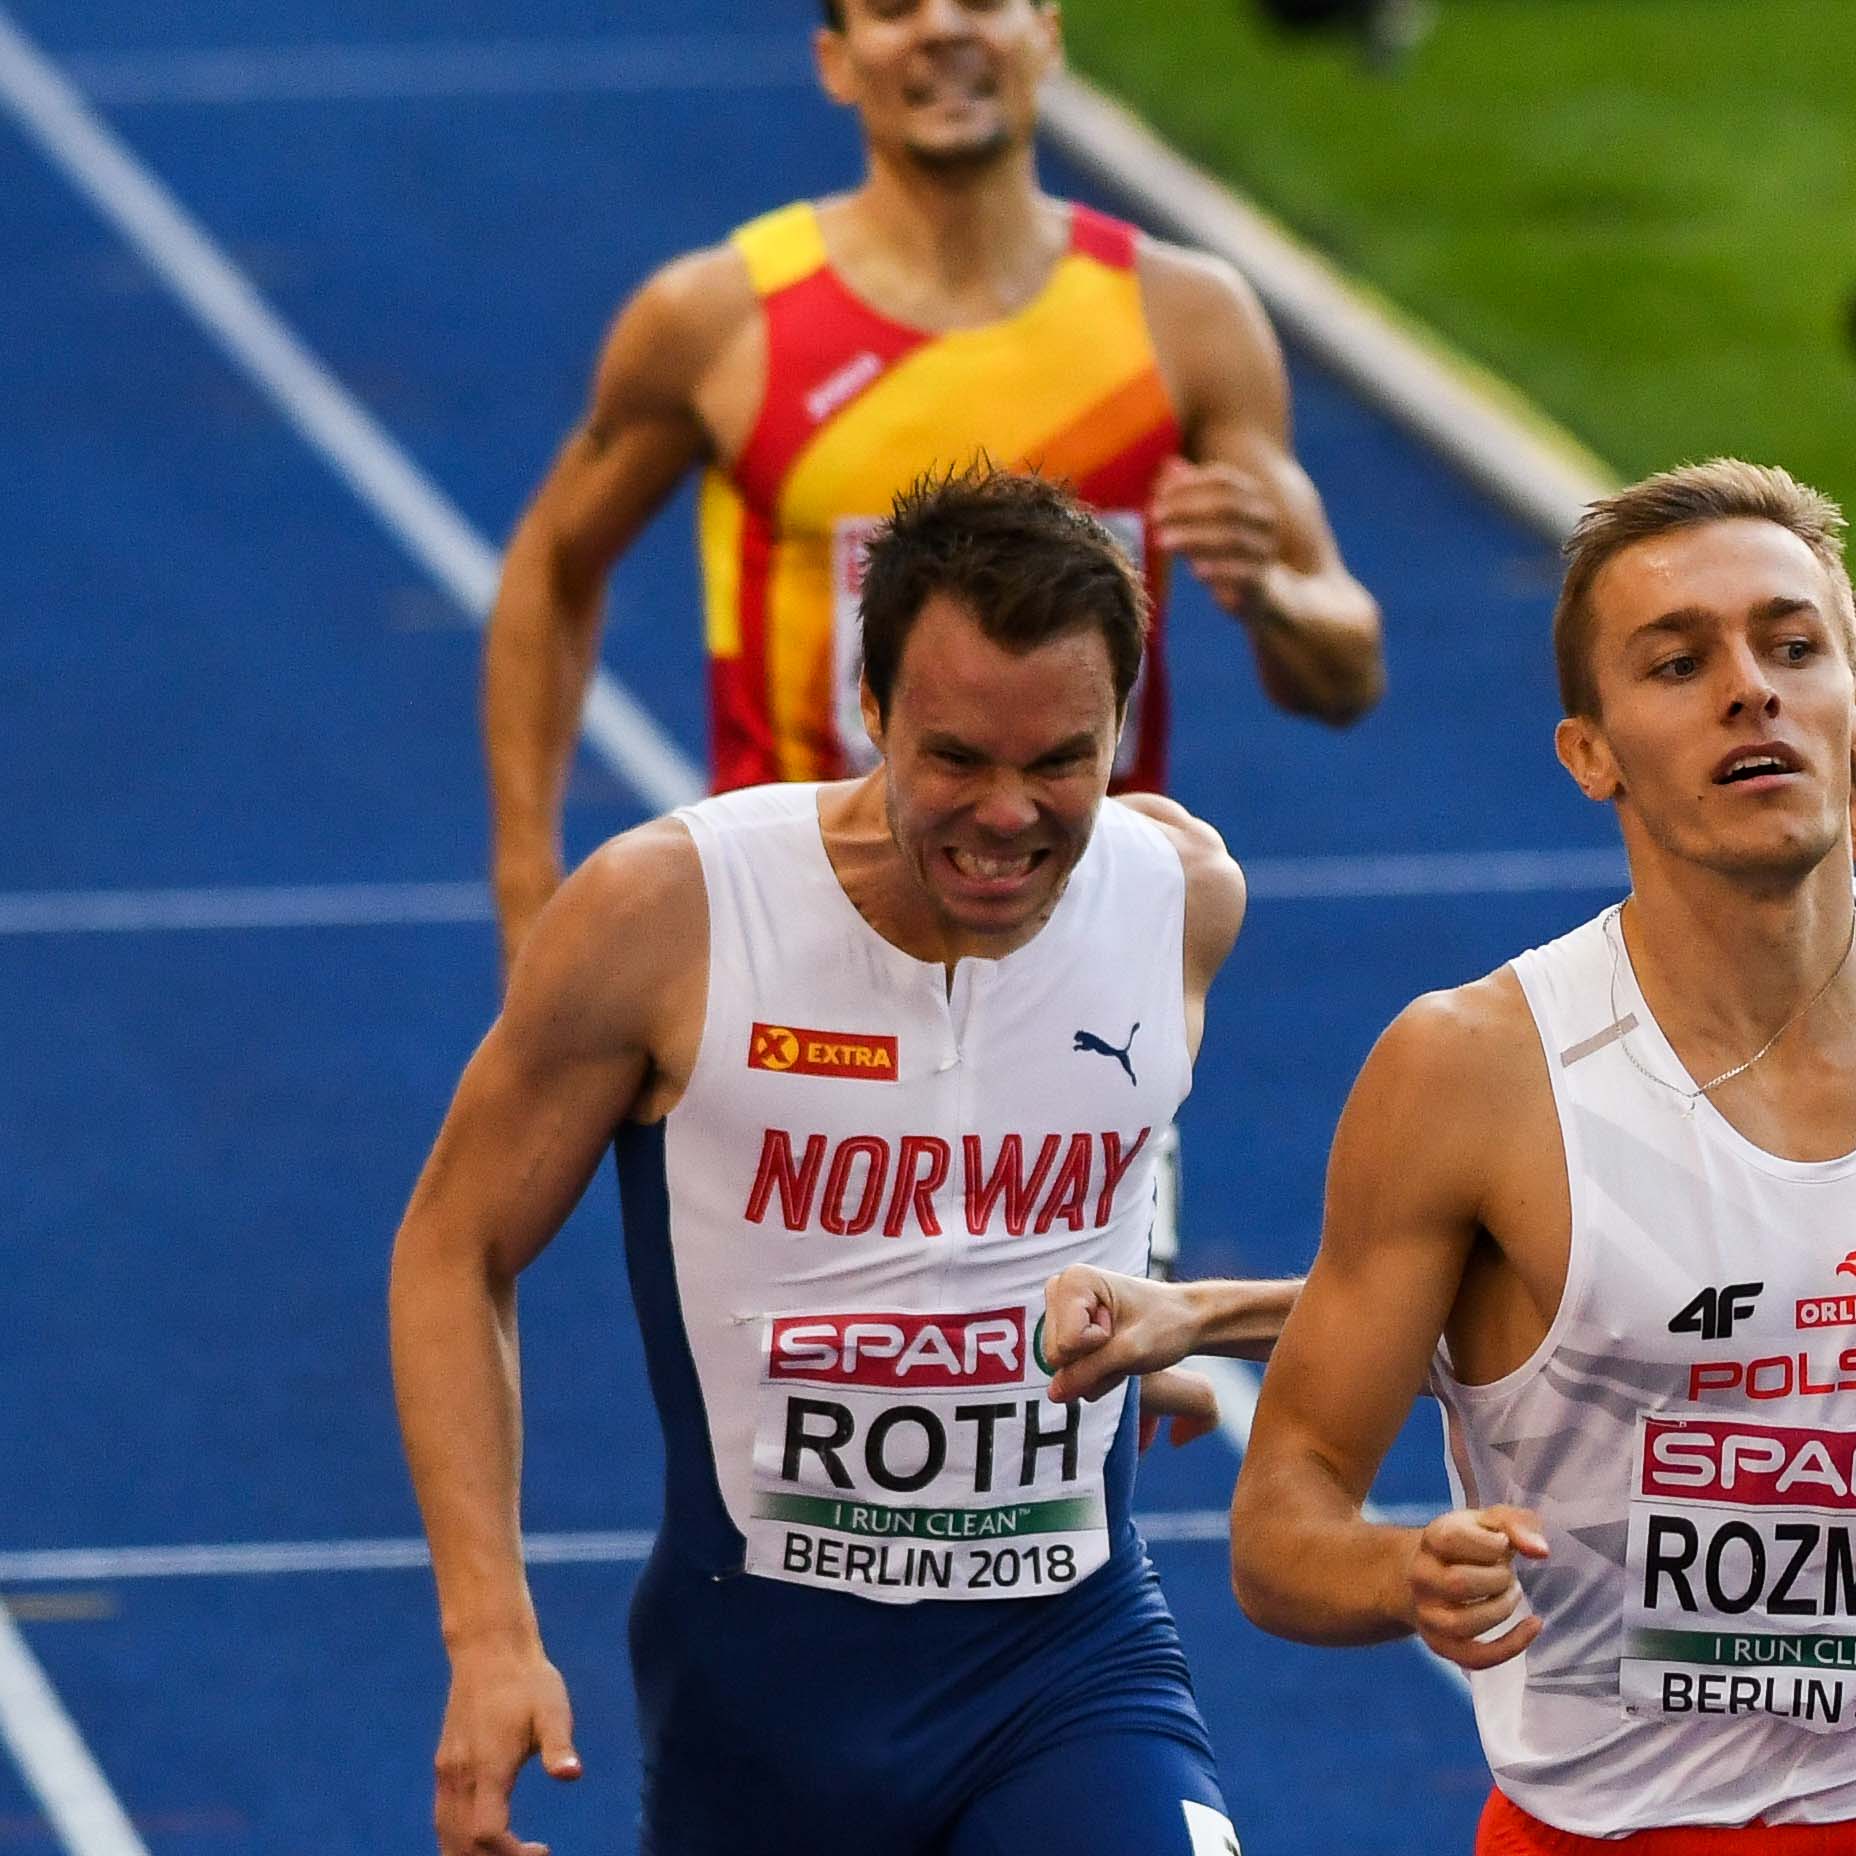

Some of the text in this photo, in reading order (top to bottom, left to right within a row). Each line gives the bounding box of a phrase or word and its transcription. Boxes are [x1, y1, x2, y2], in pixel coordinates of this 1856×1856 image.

[807, 1042, 892, 1068] EXTRA
[744, 1126, 1151, 1238] NORWAY
[1667, 1282, 1764, 1340] 4F
[778, 1320, 1019, 1378] SPAR
[781, 1396, 1082, 1494] ROTH
[833, 1507, 842, 1527] I
[851, 1508, 914, 1532] RUN
[783, 1531, 1077, 1589] BERLIN 2018
[1714, 1639, 1723, 1661] I
[1734, 1640, 1802, 1663] RUN
[1662, 1674, 1843, 1724] BERLIN
